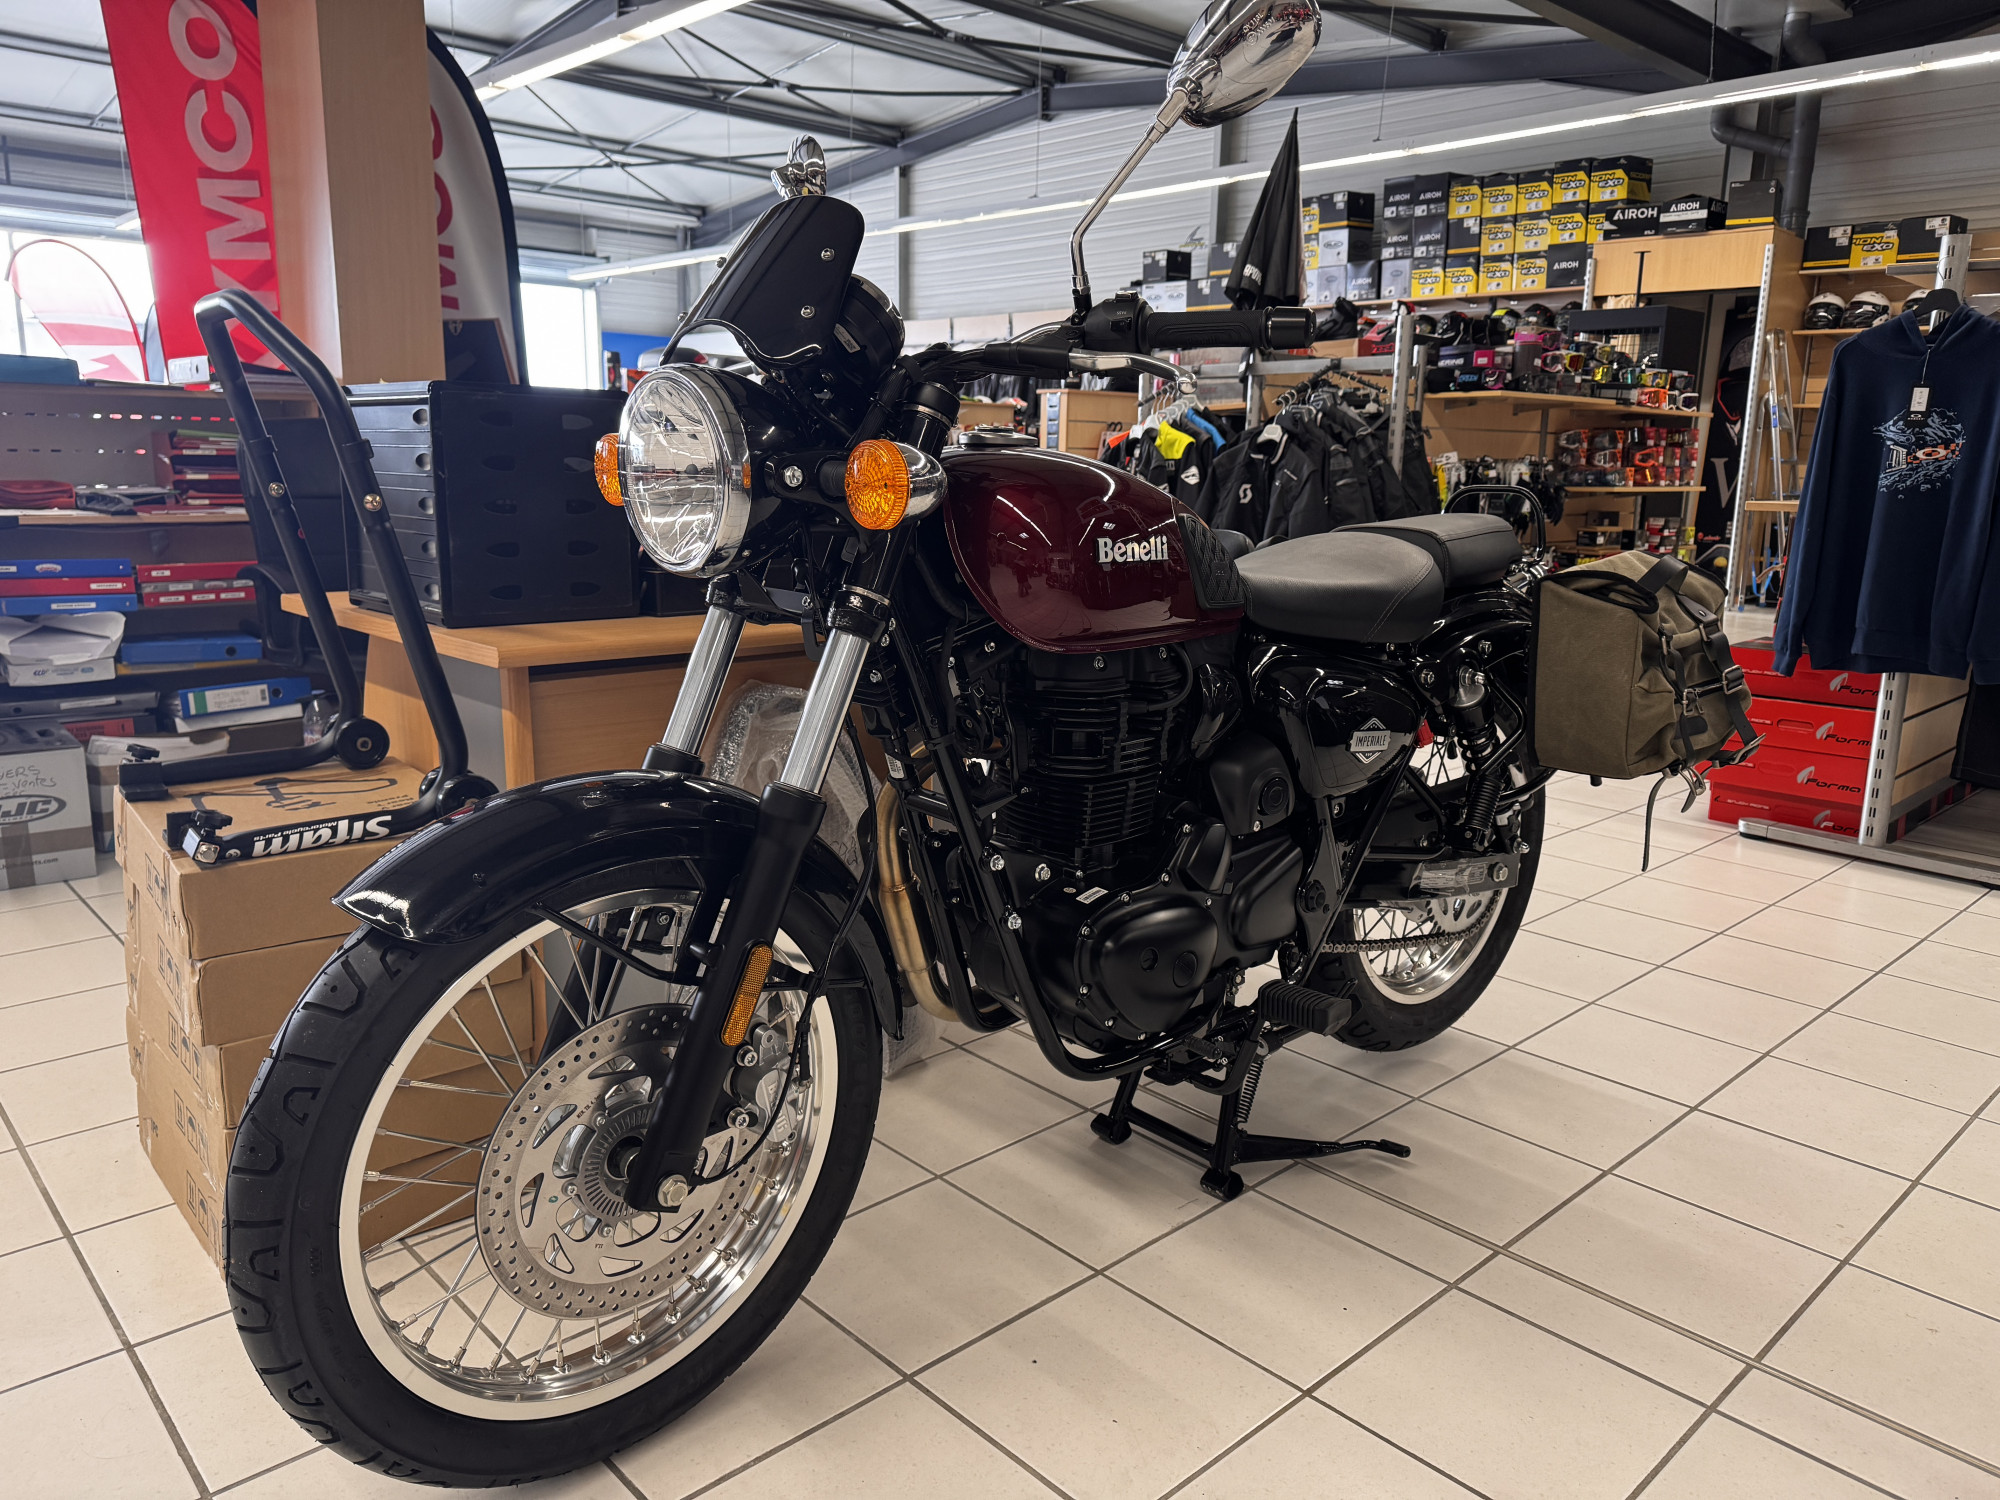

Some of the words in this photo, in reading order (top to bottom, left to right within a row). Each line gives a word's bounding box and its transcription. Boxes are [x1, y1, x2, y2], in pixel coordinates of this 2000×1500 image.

[1560, 179, 1586, 189] EXO
[1598, 178, 1624, 188] EXO
[1389, 193, 1410, 202] AIROH
[1419, 191, 1442, 200] AIROH
[1456, 194, 1479, 202] EXO
[1489, 194, 1513, 203] EXO
[1525, 190, 1549, 199] EXO
[1670, 201, 1700, 212] AIROH
[1612, 207, 1658, 220] AIROH
[1558, 222, 1582, 230] EXO
[1488, 232, 1512, 240] EXO
[1523, 228, 1547, 236] EXO
[1387, 235, 1408, 243] AIROH
[1418, 233, 1440, 242] AIROH
[1862, 242, 1894, 252] EXO
[1553, 261, 1579, 270] AIROH
[1487, 270, 1509, 278] EXO
[1521, 267, 1545, 275] EXO
[1451, 275, 1473, 283] EXO
[1097, 535, 1169, 563] Benelli
[1355, 735, 1387, 747] IMPERIALE
[1824, 734, 1871, 747] Form
[1805, 778, 1861, 793] Forma
[0, 799, 53, 818] JC
[283, 821, 337, 835] Motorcycle
[252, 815, 392, 857] Sifam
[253, 832, 282, 841] Parts
